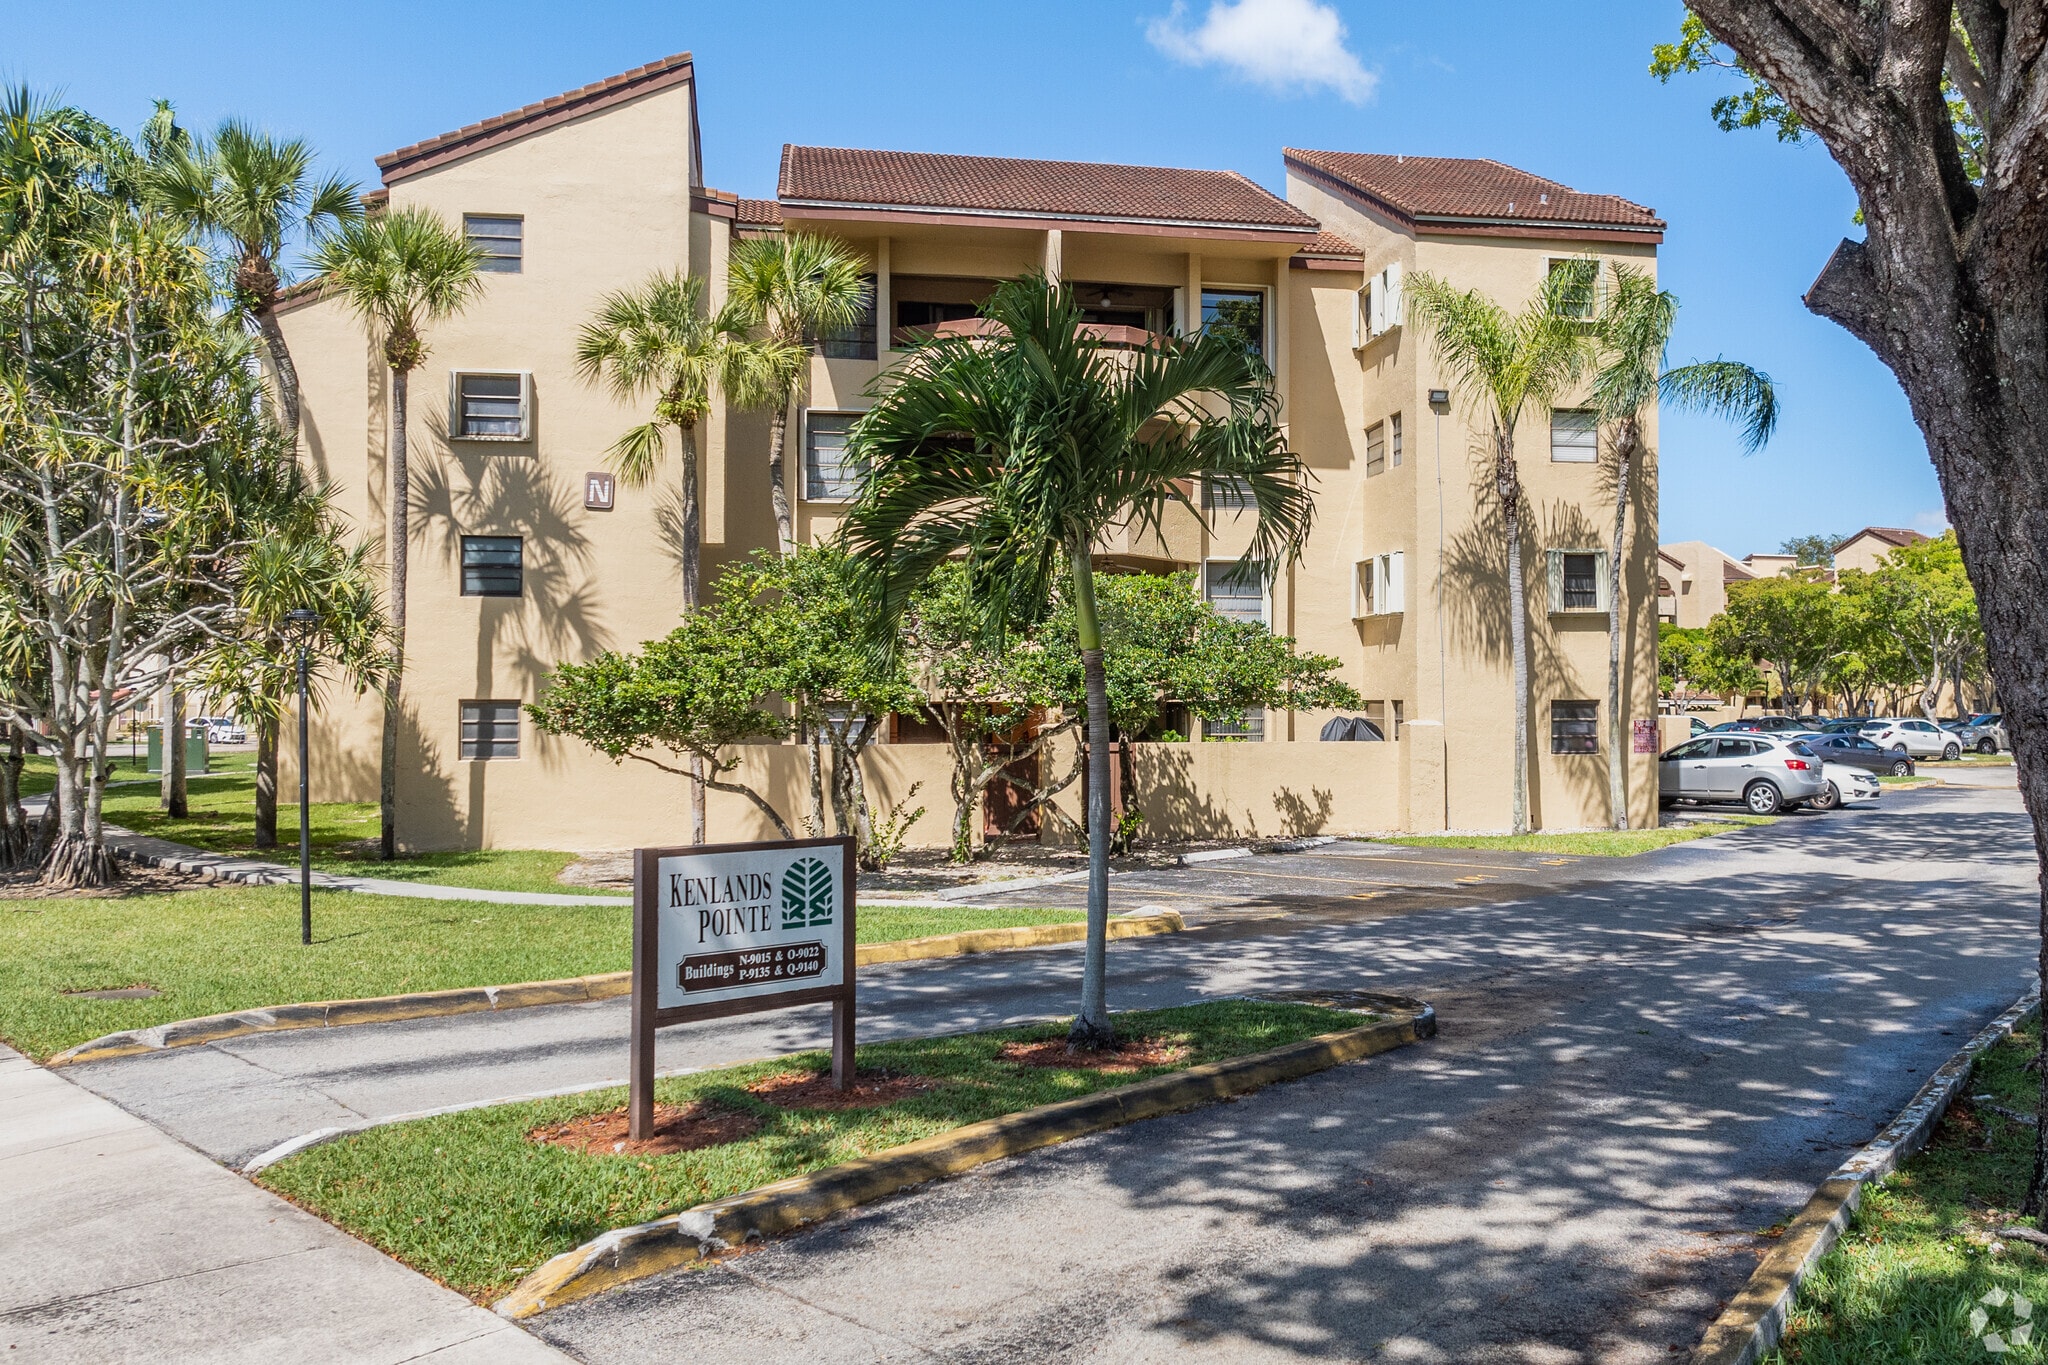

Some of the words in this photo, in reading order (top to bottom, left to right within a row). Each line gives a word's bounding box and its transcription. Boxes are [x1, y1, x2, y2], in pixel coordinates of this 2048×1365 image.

[589, 479, 609, 502] N
[669, 872, 772, 908] KENLANDS
[698, 904, 772, 943] POINTE
[739, 951, 771, 966] N-9015
[774, 950, 783, 961] &
[684, 963, 735, 981] Buildings
[739, 966, 770, 981] P-9135
[774, 965, 783, 976] &
[787, 960, 819, 975] Q-9140
